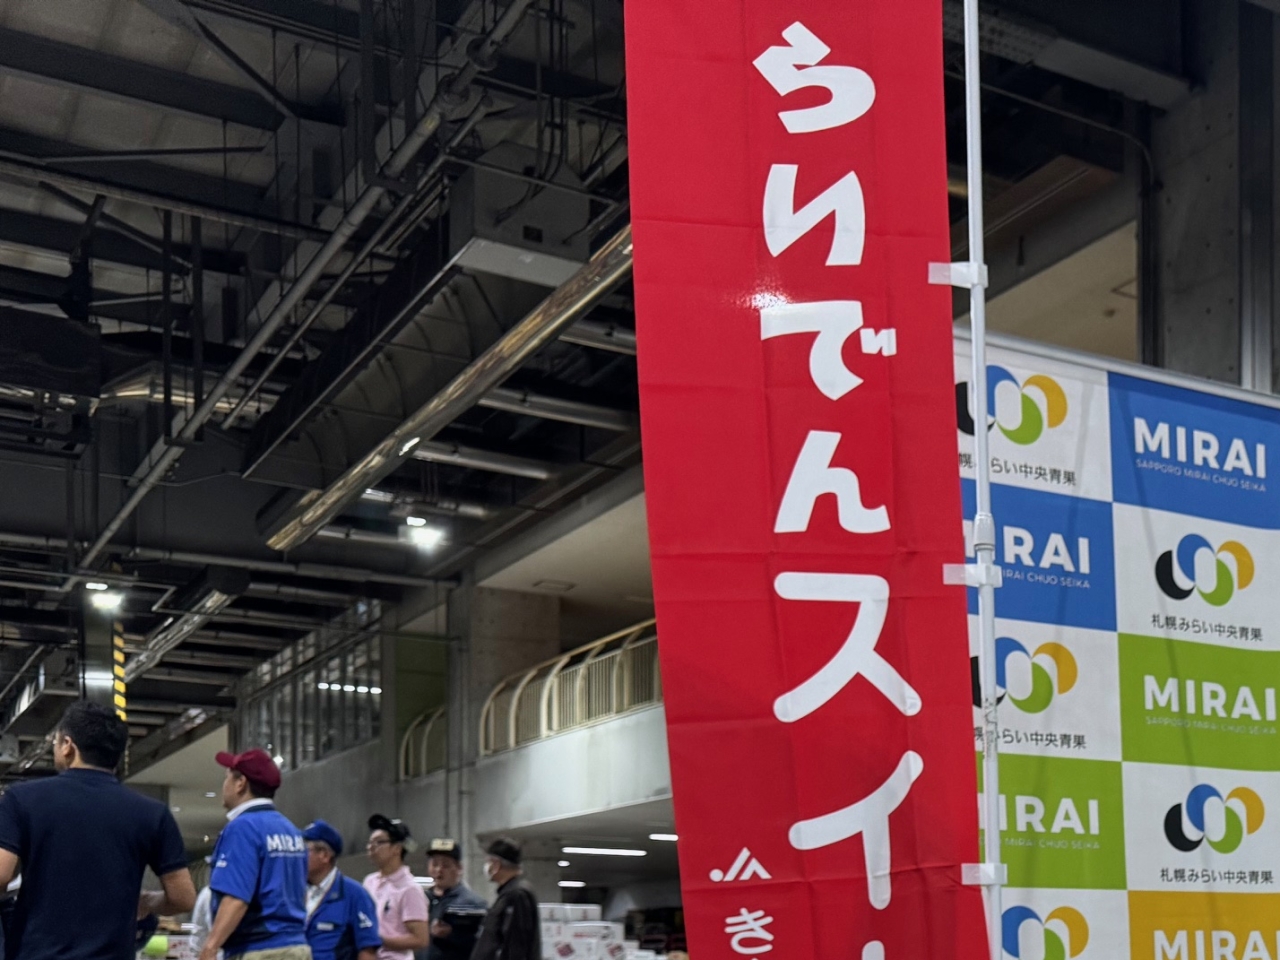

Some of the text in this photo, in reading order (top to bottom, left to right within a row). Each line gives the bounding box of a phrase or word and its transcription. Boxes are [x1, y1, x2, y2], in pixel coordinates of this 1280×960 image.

[1134, 416, 1268, 479] MIRAI
[958, 452, 1078, 486] 幌らい中央青果
[1135, 459, 1267, 492] SAPPORO MIRAI CHUO SEIKA
[963, 519, 1091, 575] RAI
[1003, 569, 1091, 590] IRAI CHUO SEIKA
[1152, 613, 1263, 641] 札幌みらい中央青果
[1143, 674, 1277, 722] MIRAI
[977, 792, 1100, 836] IRAI
[266, 833, 305, 852] MIRA
[1160, 868, 1274, 885] 札幌みらい中央青果
